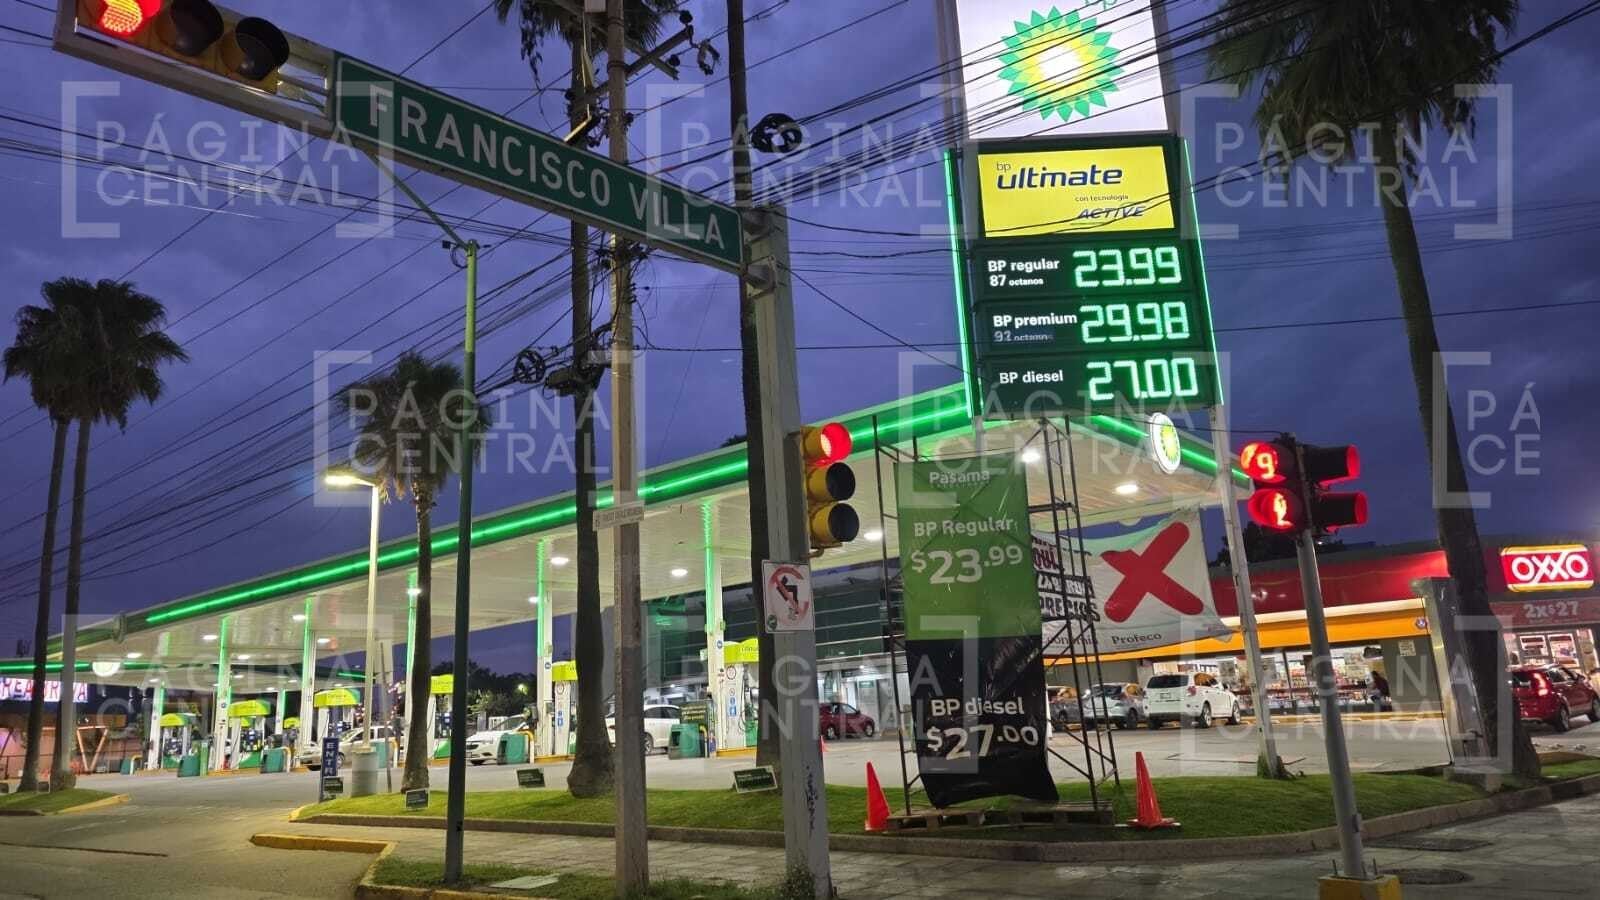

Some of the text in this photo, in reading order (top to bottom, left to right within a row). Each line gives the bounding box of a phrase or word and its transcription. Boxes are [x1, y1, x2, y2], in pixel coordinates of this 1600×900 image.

[370, 83, 726, 250] FRANCISCO VILLA
[996, 161, 1011, 172] bp
[997, 164, 1123, 189] ultimate
[1078, 204, 1146, 219] ACTIVE
[987, 246, 1182, 287] BP regular 23.99
[989, 275, 1044, 286] 87 octanos
[993, 301, 1190, 343] BP premium 29.98
[1000, 357, 1199, 401] BP diesel 27.00
[914, 516, 1014, 537] BP Regular
[910, 544, 1023, 585] $23.99
[1511, 550, 1589, 585] OXXO
[1111, 632, 1163, 645] Profeco
[930, 696, 1025, 716] BP diesel
[926, 724, 1039, 761] $27.00
